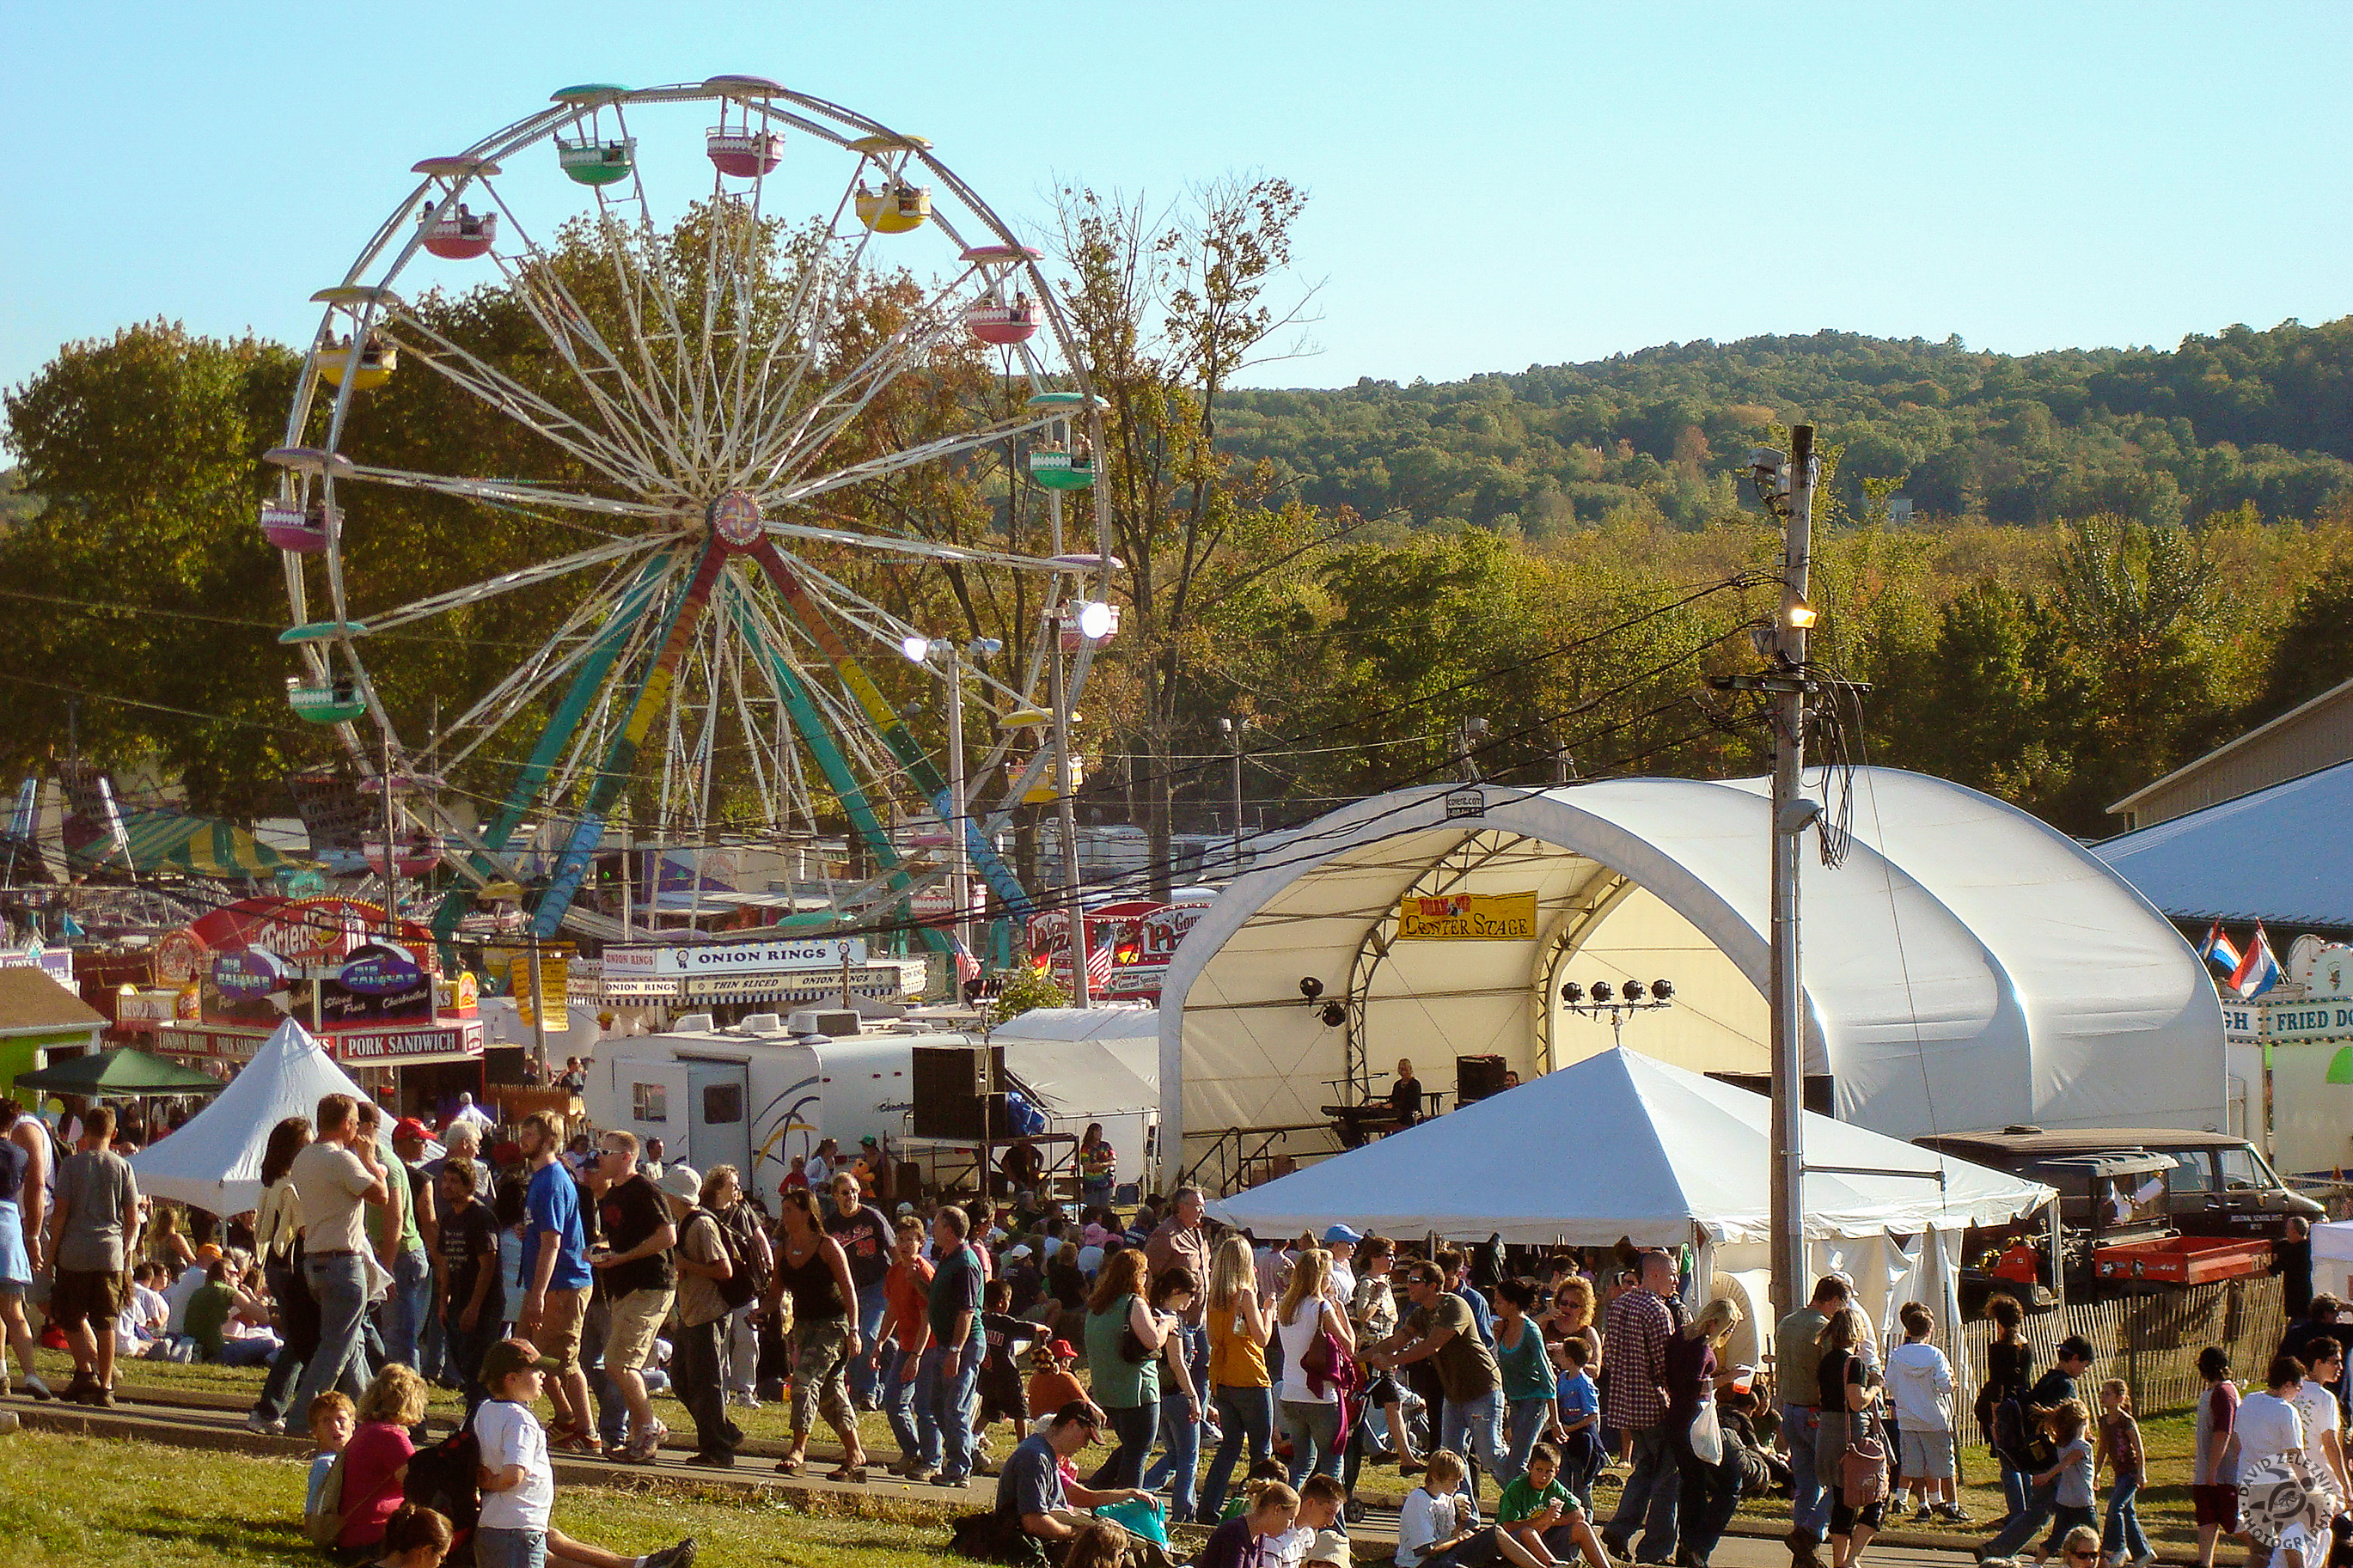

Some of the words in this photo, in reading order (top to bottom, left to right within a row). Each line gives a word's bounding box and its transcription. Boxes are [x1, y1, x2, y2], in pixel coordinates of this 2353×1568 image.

[1406, 914, 1470, 935] CENTER
[1473, 912, 1527, 936] STAGE
[606, 954, 627, 964] ONION
[631, 955, 653, 966] RINGS
[698, 949, 761, 964] ONION
[767, 949, 827, 960] RINGS
[713, 980, 738, 990] THIN
[743, 979, 779, 989] SLICED
[803, 977, 834, 985] ONION
[837, 974, 869, 984] RNGS
[2277, 1011, 2329, 1031] FRIED
[348, 1037, 384, 1056] PORK
[388, 1034, 455, 1053] SANDWICH
